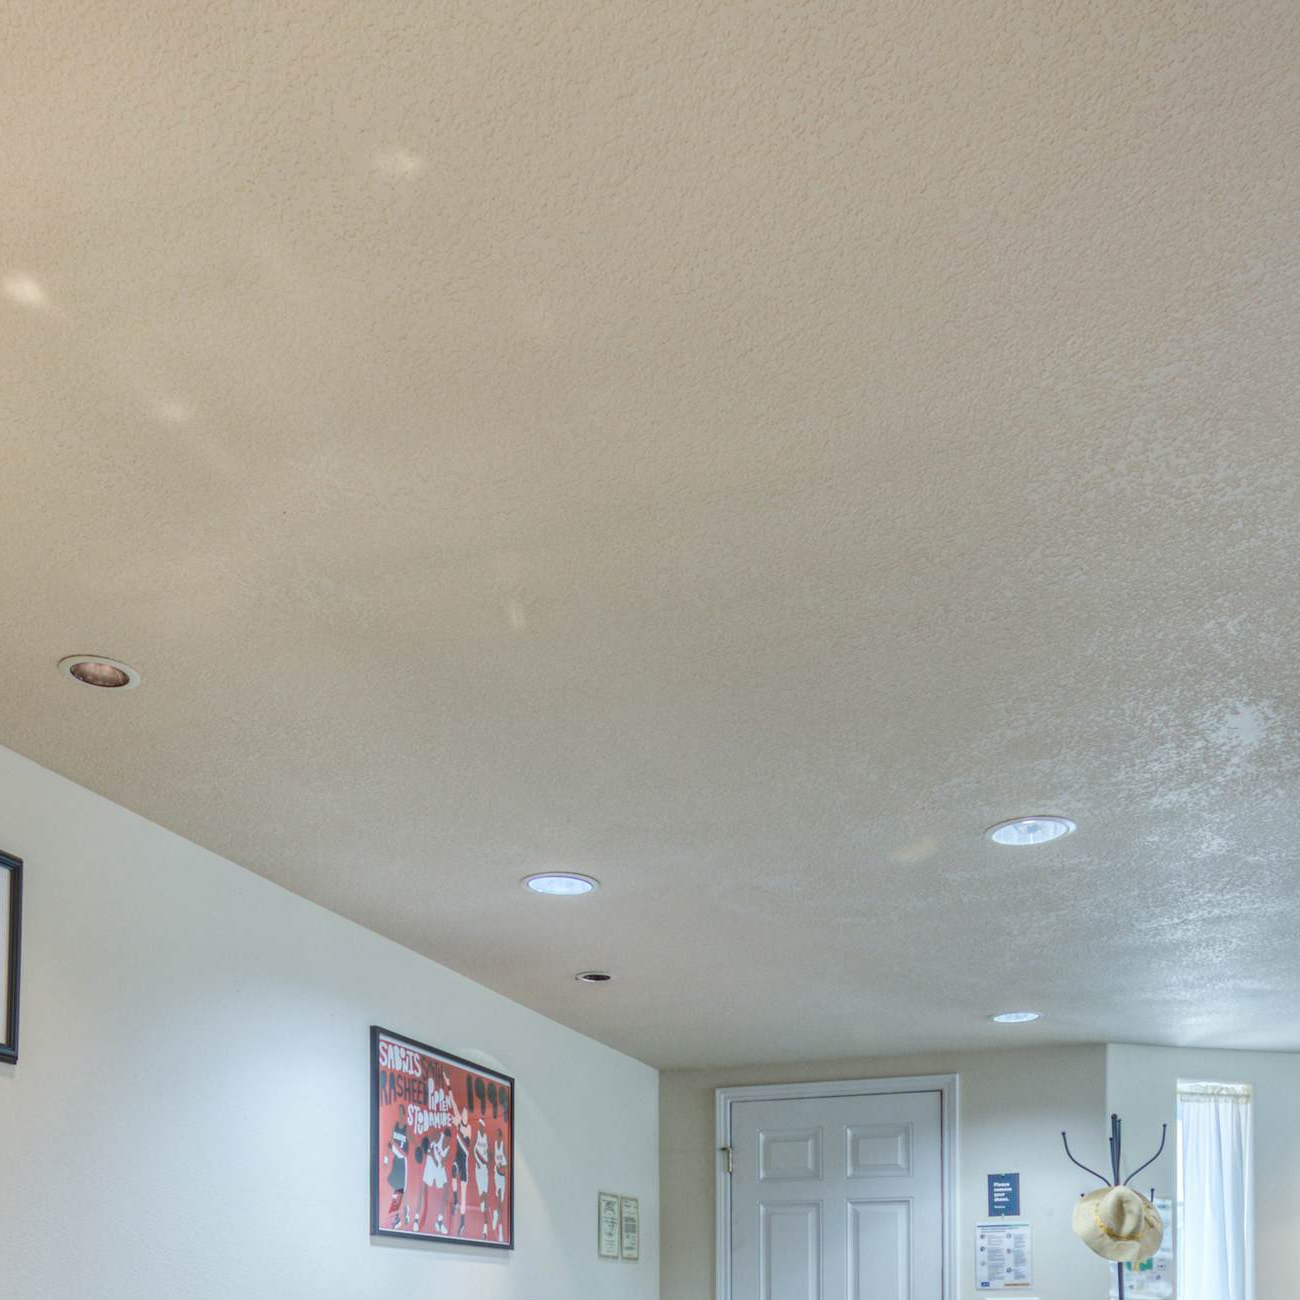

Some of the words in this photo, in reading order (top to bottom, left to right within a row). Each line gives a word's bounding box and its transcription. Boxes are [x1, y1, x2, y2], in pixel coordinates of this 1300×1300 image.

[379, 1041, 421, 1077] SABONIS
[427, 1077, 452, 1112] PIPPEN
[466, 1073, 508, 1122] 1999
